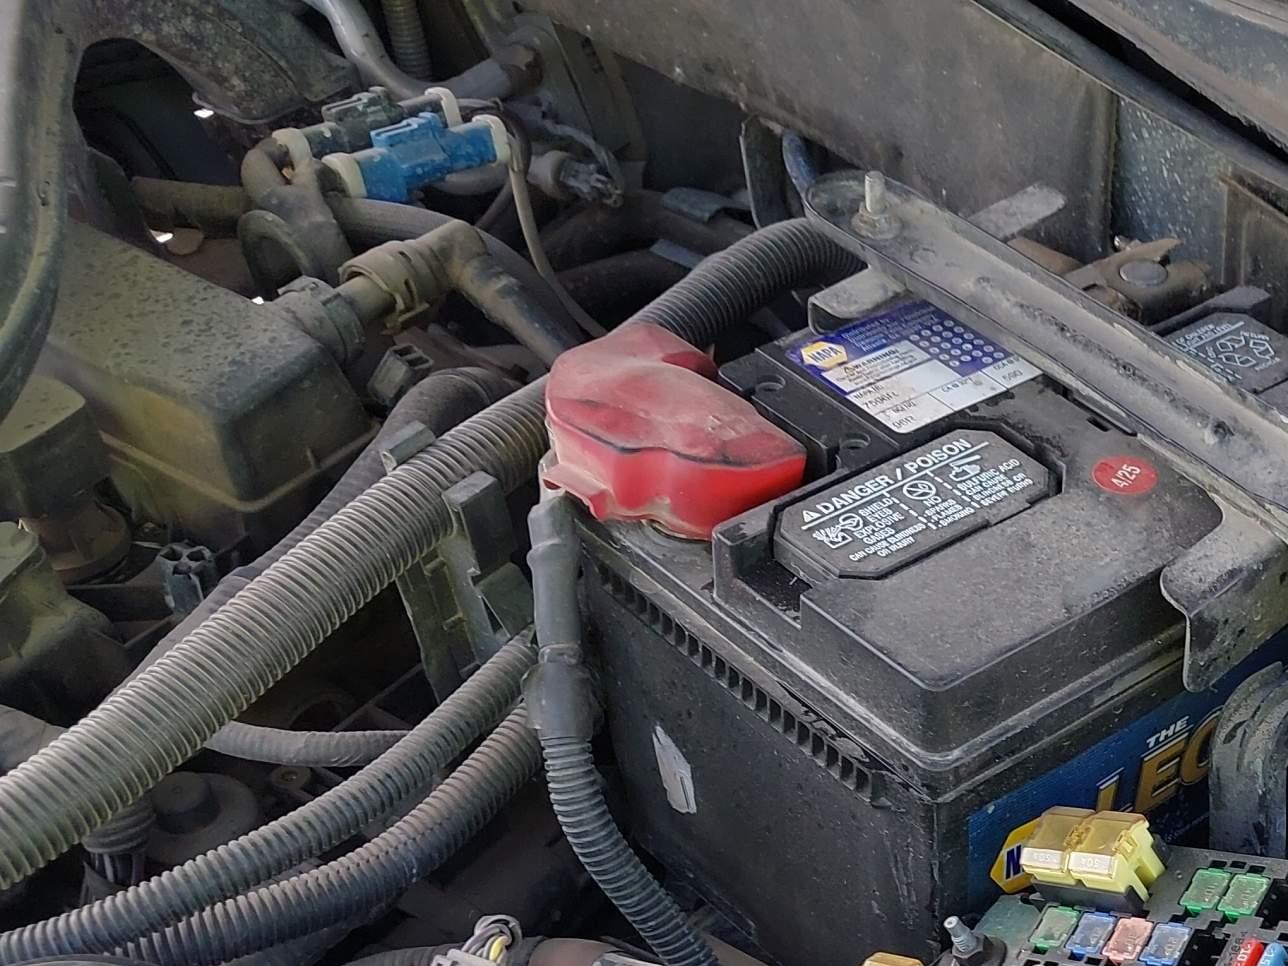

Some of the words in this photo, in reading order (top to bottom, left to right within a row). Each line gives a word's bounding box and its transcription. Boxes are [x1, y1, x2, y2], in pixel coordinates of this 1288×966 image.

[807, 345, 842, 363] NAPA
[816, 475, 895, 514] DANGER
[904, 438, 972, 474] POISON
[957, 468, 999, 491] SULFURIC
[998, 459, 1020, 472] ACID
[982, 473, 1008, 488] CAUSE
[1111, 463, 1141, 488] 4/25
[858, 497, 894, 516] SHIELD
[923, 495, 942, 507] NO
[866, 508, 893, 523] EYES
[853, 511, 905, 539] EXPLOSIVE
[863, 527, 896, 545] GASES
[849, 550, 867, 561] CAN
[1146, 715, 1190, 748] THE
